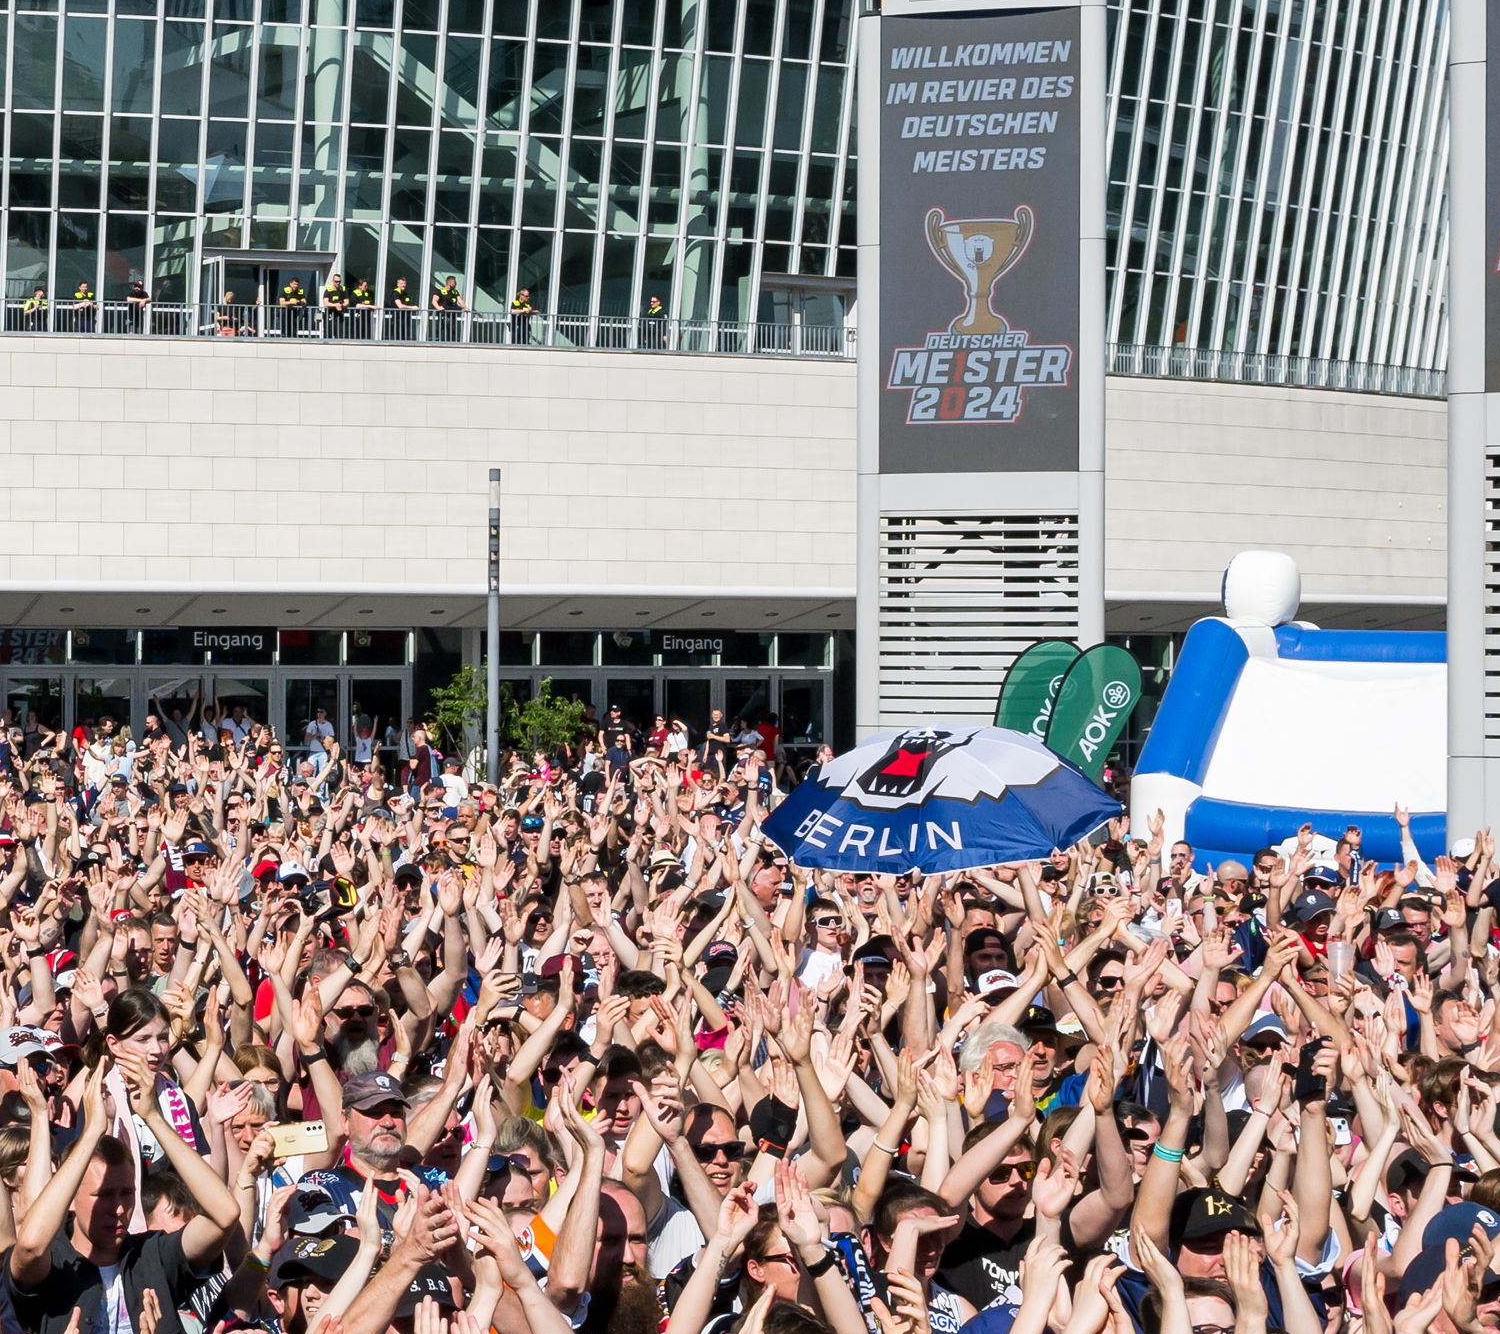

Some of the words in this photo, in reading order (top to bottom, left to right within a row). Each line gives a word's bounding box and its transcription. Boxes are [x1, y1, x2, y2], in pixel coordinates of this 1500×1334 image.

[890, 40, 1072, 70] WILLKOMMEN
[886, 82, 916, 105] IM
[921, 78, 1017, 104] REVIER
[1020, 75, 1076, 101] DES
[901, 110, 1059, 140] DEUTSCHEN
[912, 146, 1047, 174] MEISTERS
[927, 334, 1027, 350] DEUTSCHER
[912, 385, 1018, 420] 2024
[193, 631, 263, 651] Eingang
[663, 635, 723, 654] Eingang
[1078, 704, 1120, 762] AOK
[794, 808, 961, 857] BERLIN
[1204, 1195, 1216, 1216] 1
